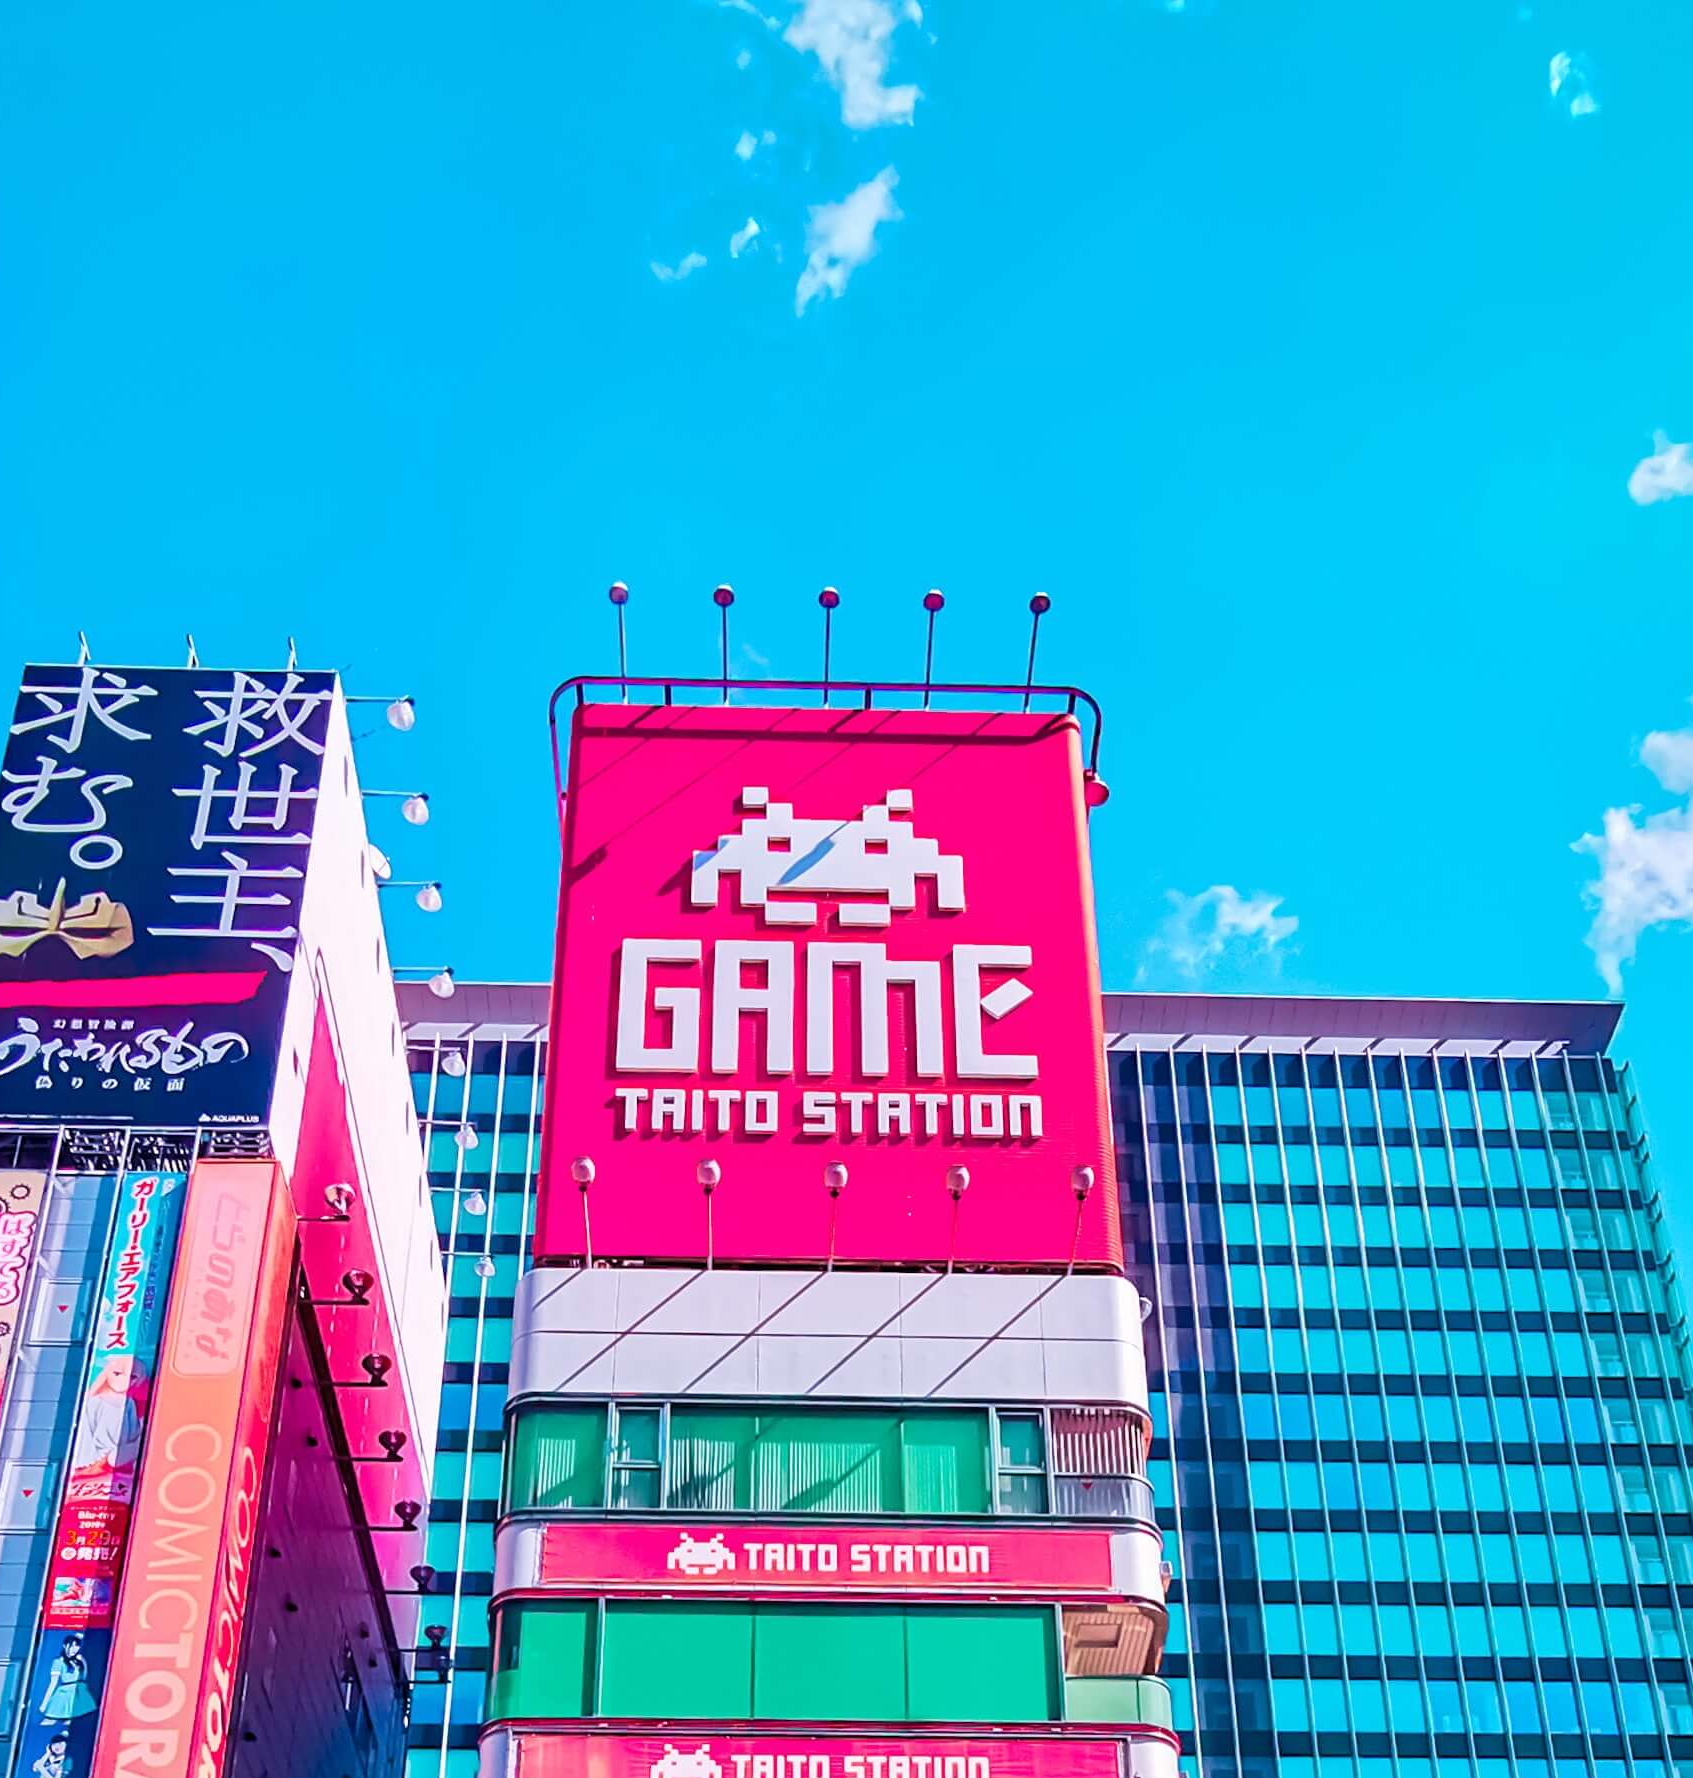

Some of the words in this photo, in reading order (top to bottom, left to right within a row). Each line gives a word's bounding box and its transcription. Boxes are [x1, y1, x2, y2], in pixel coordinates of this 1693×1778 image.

[616, 939, 1039, 1080] GAME
[616, 1088, 778, 1134] TAITO
[803, 1091, 1042, 1138] STATION
[744, 1542, 837, 1572] TAITO
[852, 1543, 989, 1573] STATION
